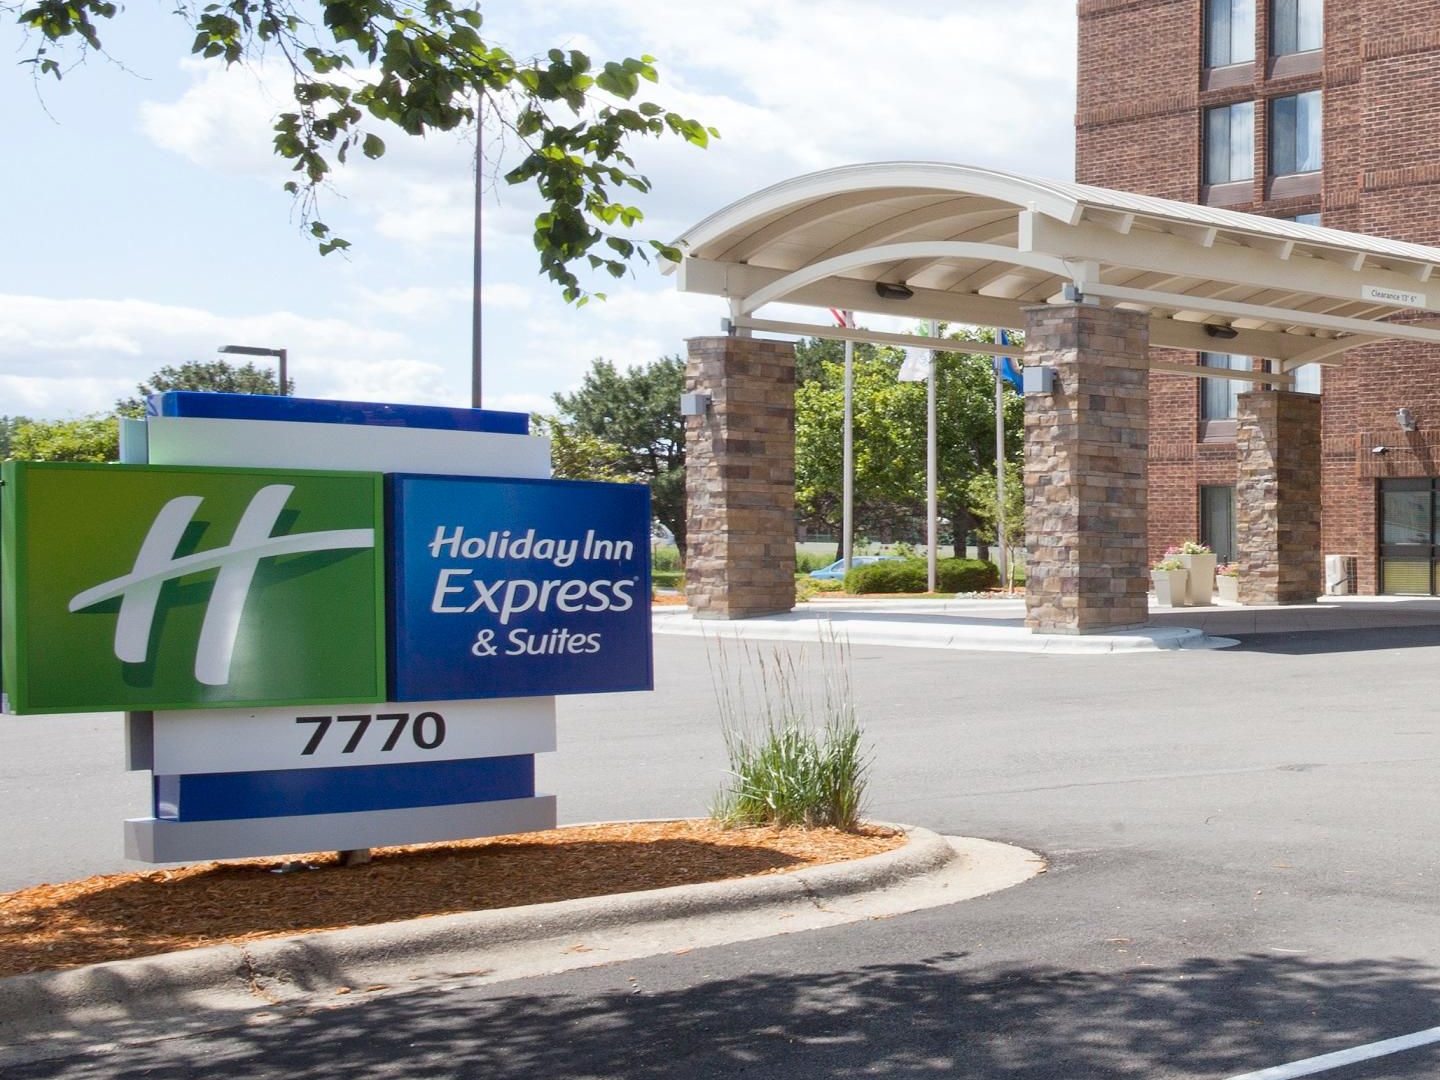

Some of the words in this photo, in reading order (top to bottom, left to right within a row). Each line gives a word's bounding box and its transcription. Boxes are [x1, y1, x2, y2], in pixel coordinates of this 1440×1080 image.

[1371, 289, 1400, 301] Clearance
[428, 525, 579, 568] Holiday
[583, 529, 634, 561] Inn
[431, 568, 635, 625] Express
[471, 628, 498, 657] &
[505, 628, 601, 656] Suites
[296, 711, 446, 756] 7770
